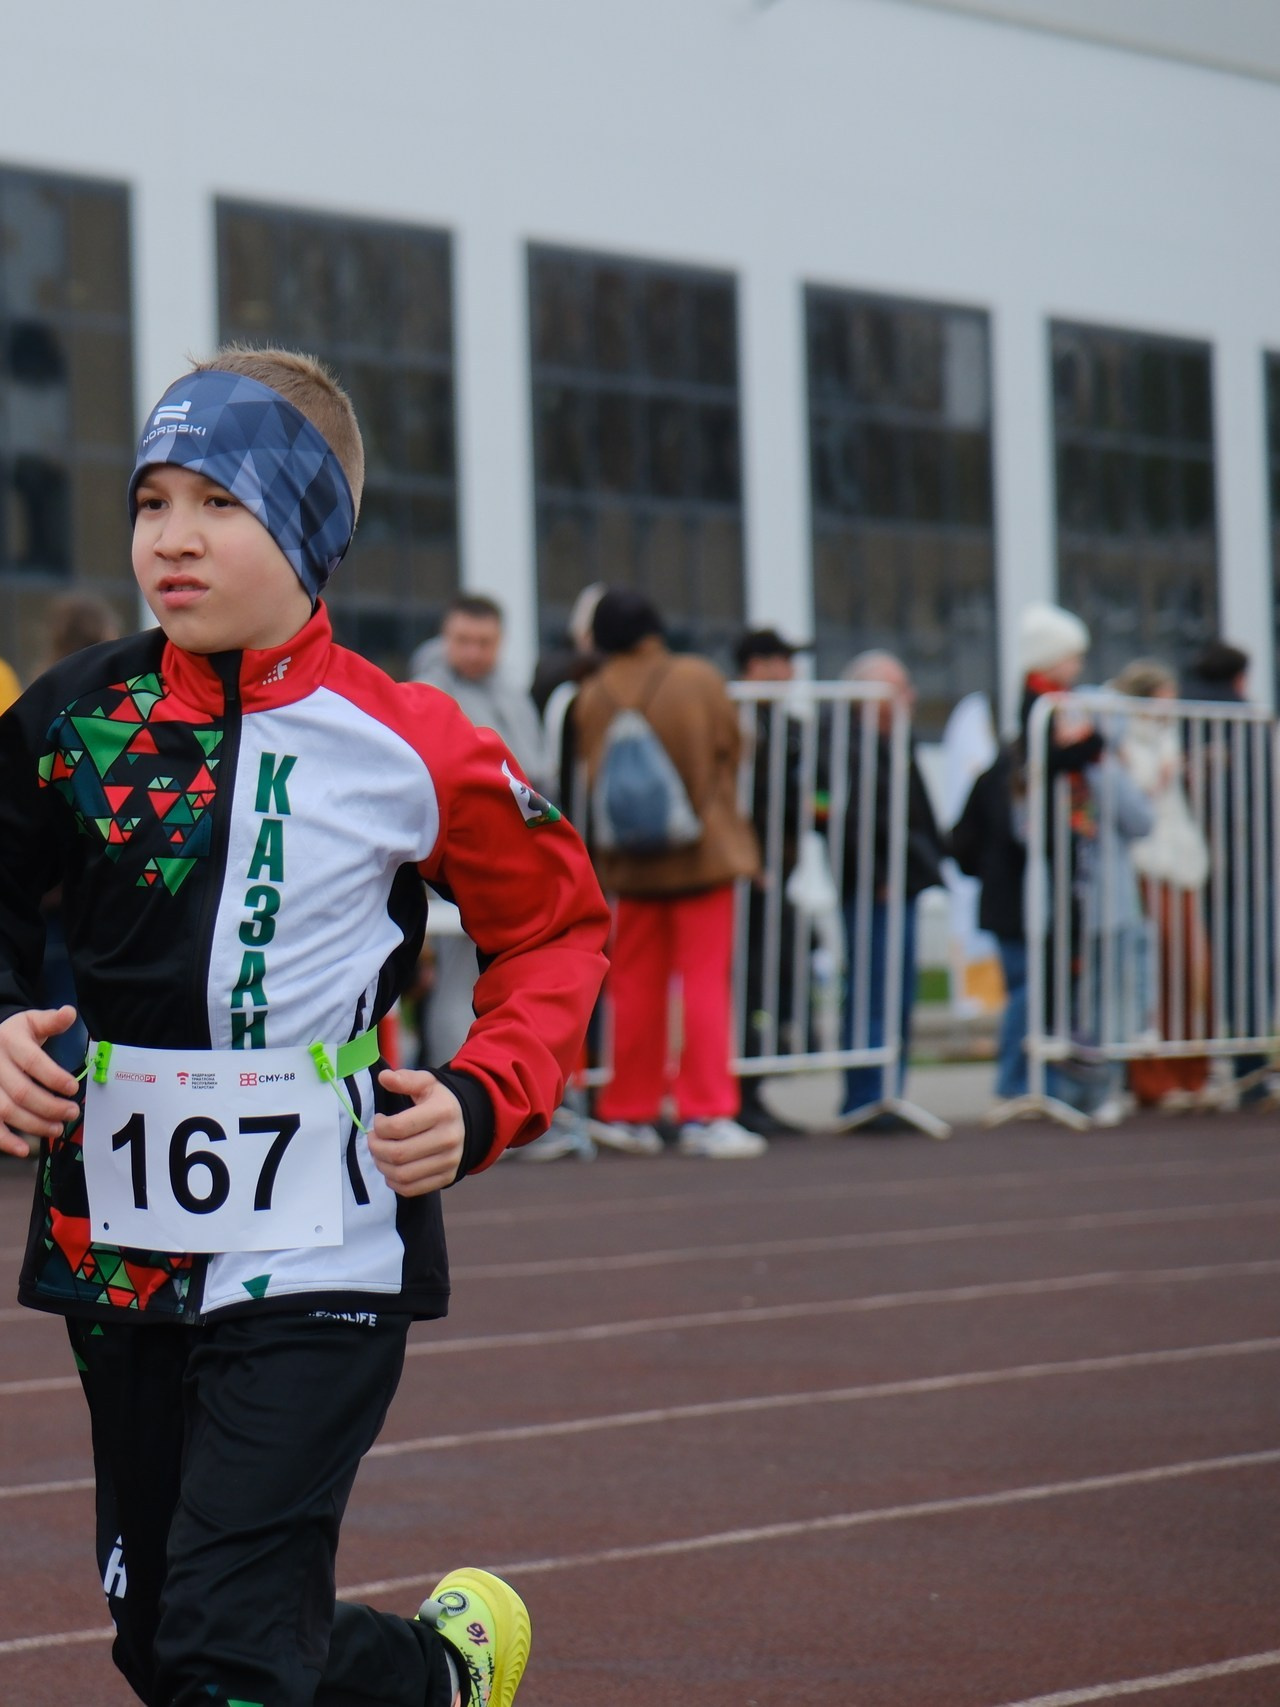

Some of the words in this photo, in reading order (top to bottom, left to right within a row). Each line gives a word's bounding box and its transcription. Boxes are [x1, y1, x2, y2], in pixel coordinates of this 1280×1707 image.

[143, 424, 207, 447] NORDSKI
[115, 1071, 157, 1083] МИНСПОРТ
[258, 1073, 296, 1083] СМУ-88
[111, 1112, 301, 1215] 167
